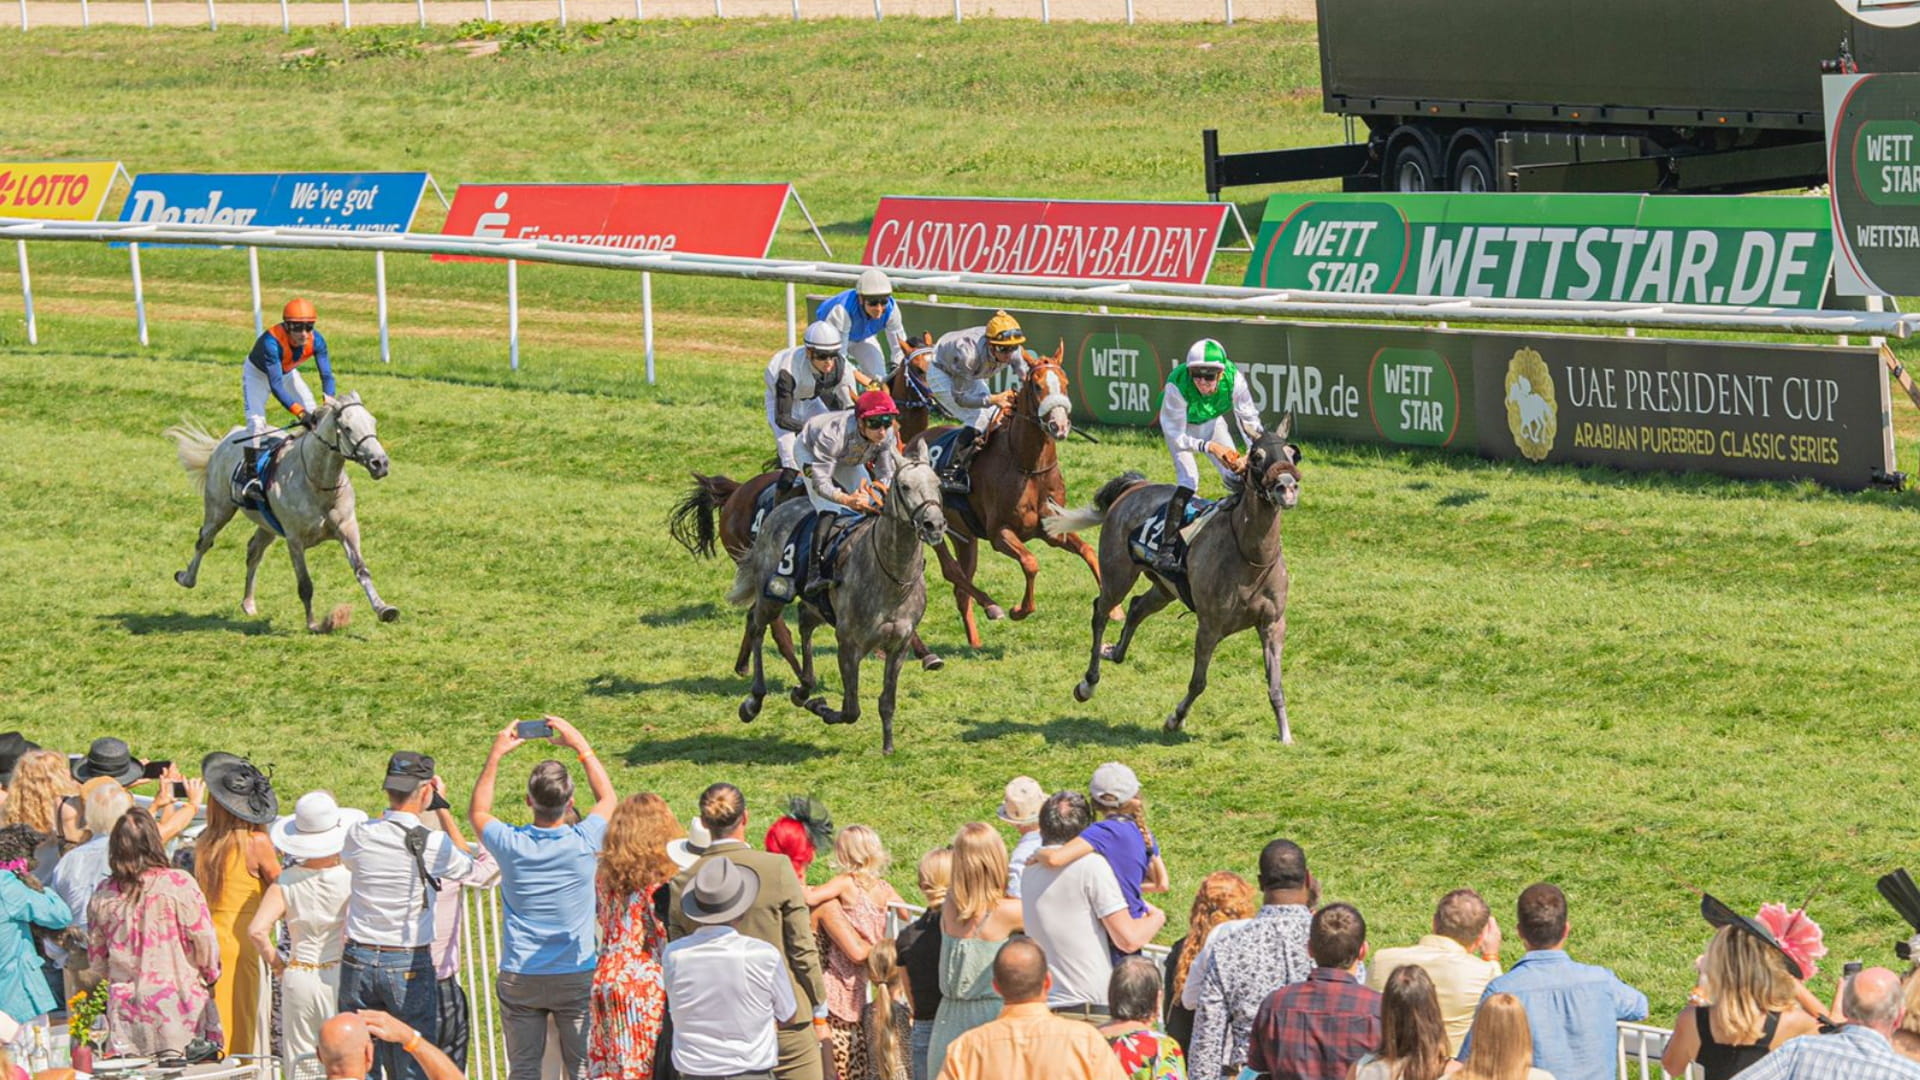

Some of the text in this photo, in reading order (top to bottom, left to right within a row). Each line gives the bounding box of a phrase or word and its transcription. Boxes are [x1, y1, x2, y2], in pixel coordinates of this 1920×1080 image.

[1866, 134, 1914, 162] WETT
[12, 174, 89, 206] LOTTO
[290, 182, 379, 216] We've got
[1293, 220, 1378, 257] WETT
[1307, 261, 1380, 293] STAR
[1416, 226, 1817, 306] WETTSTAR.DE
[1091, 347, 1139, 378] WETT
[1383, 363, 1433, 396] WETT
[1108, 381, 1151, 412] STAR
[1565, 366, 1839, 421] UAE PRESIDENT CUP
[1400, 398, 1444, 432] STAR
[1574, 422, 1840, 464] ARABIAN PUREBRED CLASSIC SERIES
[1138, 514, 1166, 551] 12
[777, 542, 796, 576] 3
